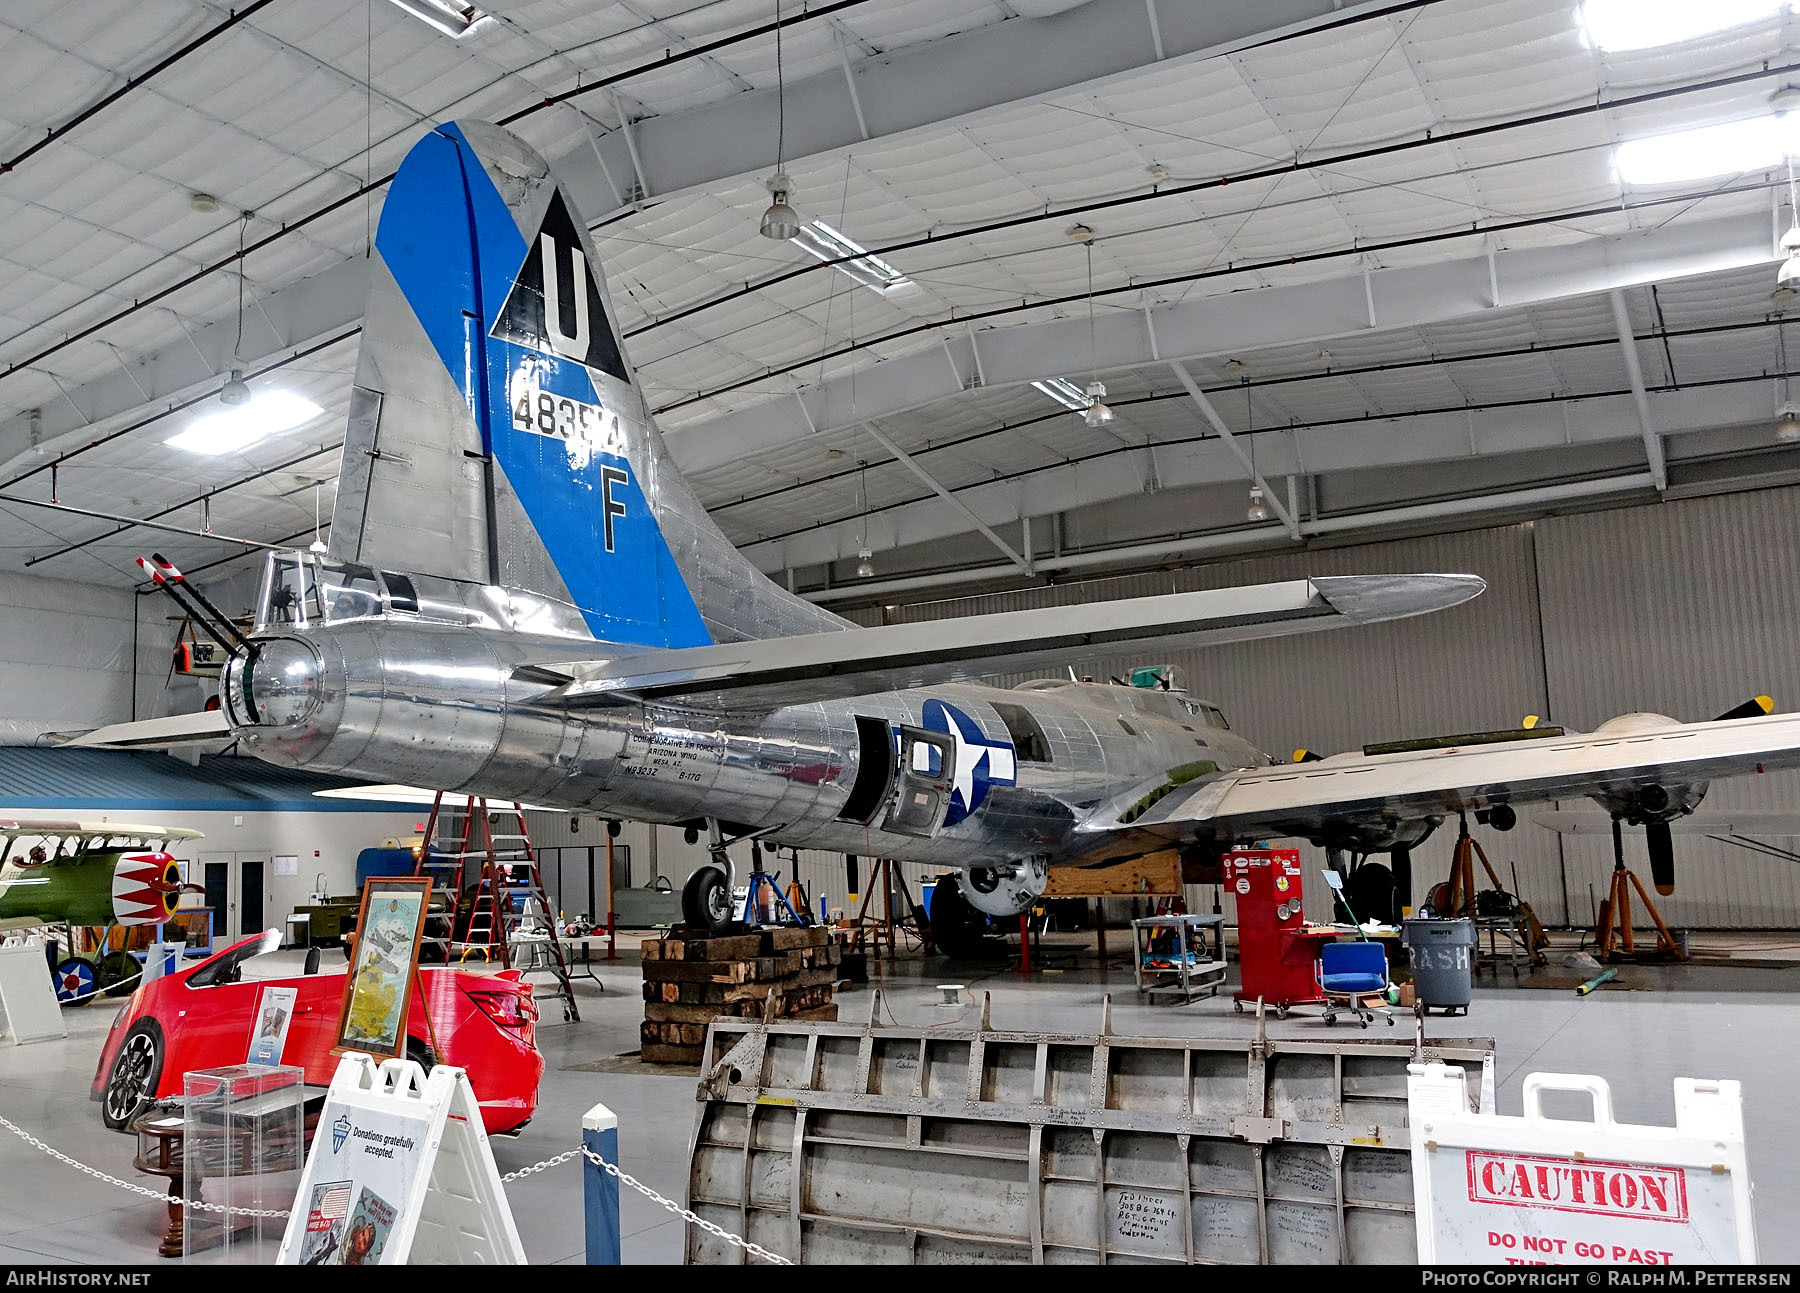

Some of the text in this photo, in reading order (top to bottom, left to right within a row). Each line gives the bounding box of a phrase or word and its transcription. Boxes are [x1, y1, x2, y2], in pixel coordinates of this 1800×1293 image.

[540, 232, 590, 362] U
[601, 464, 629, 553] F
[633, 735, 715, 753] COMMEMORATIVE AIR FORCE
[648, 748, 698, 760] ARIZONA WING
[625, 766, 702, 781] N9323Z B-17G
[353, 1127, 415, 1151] Donations gratefully
[364, 1145, 394, 1159] accepted.
[1481, 1160, 1669, 1212] CAUTION
[1488, 1231, 1673, 1265] DO NOT GO PAST
